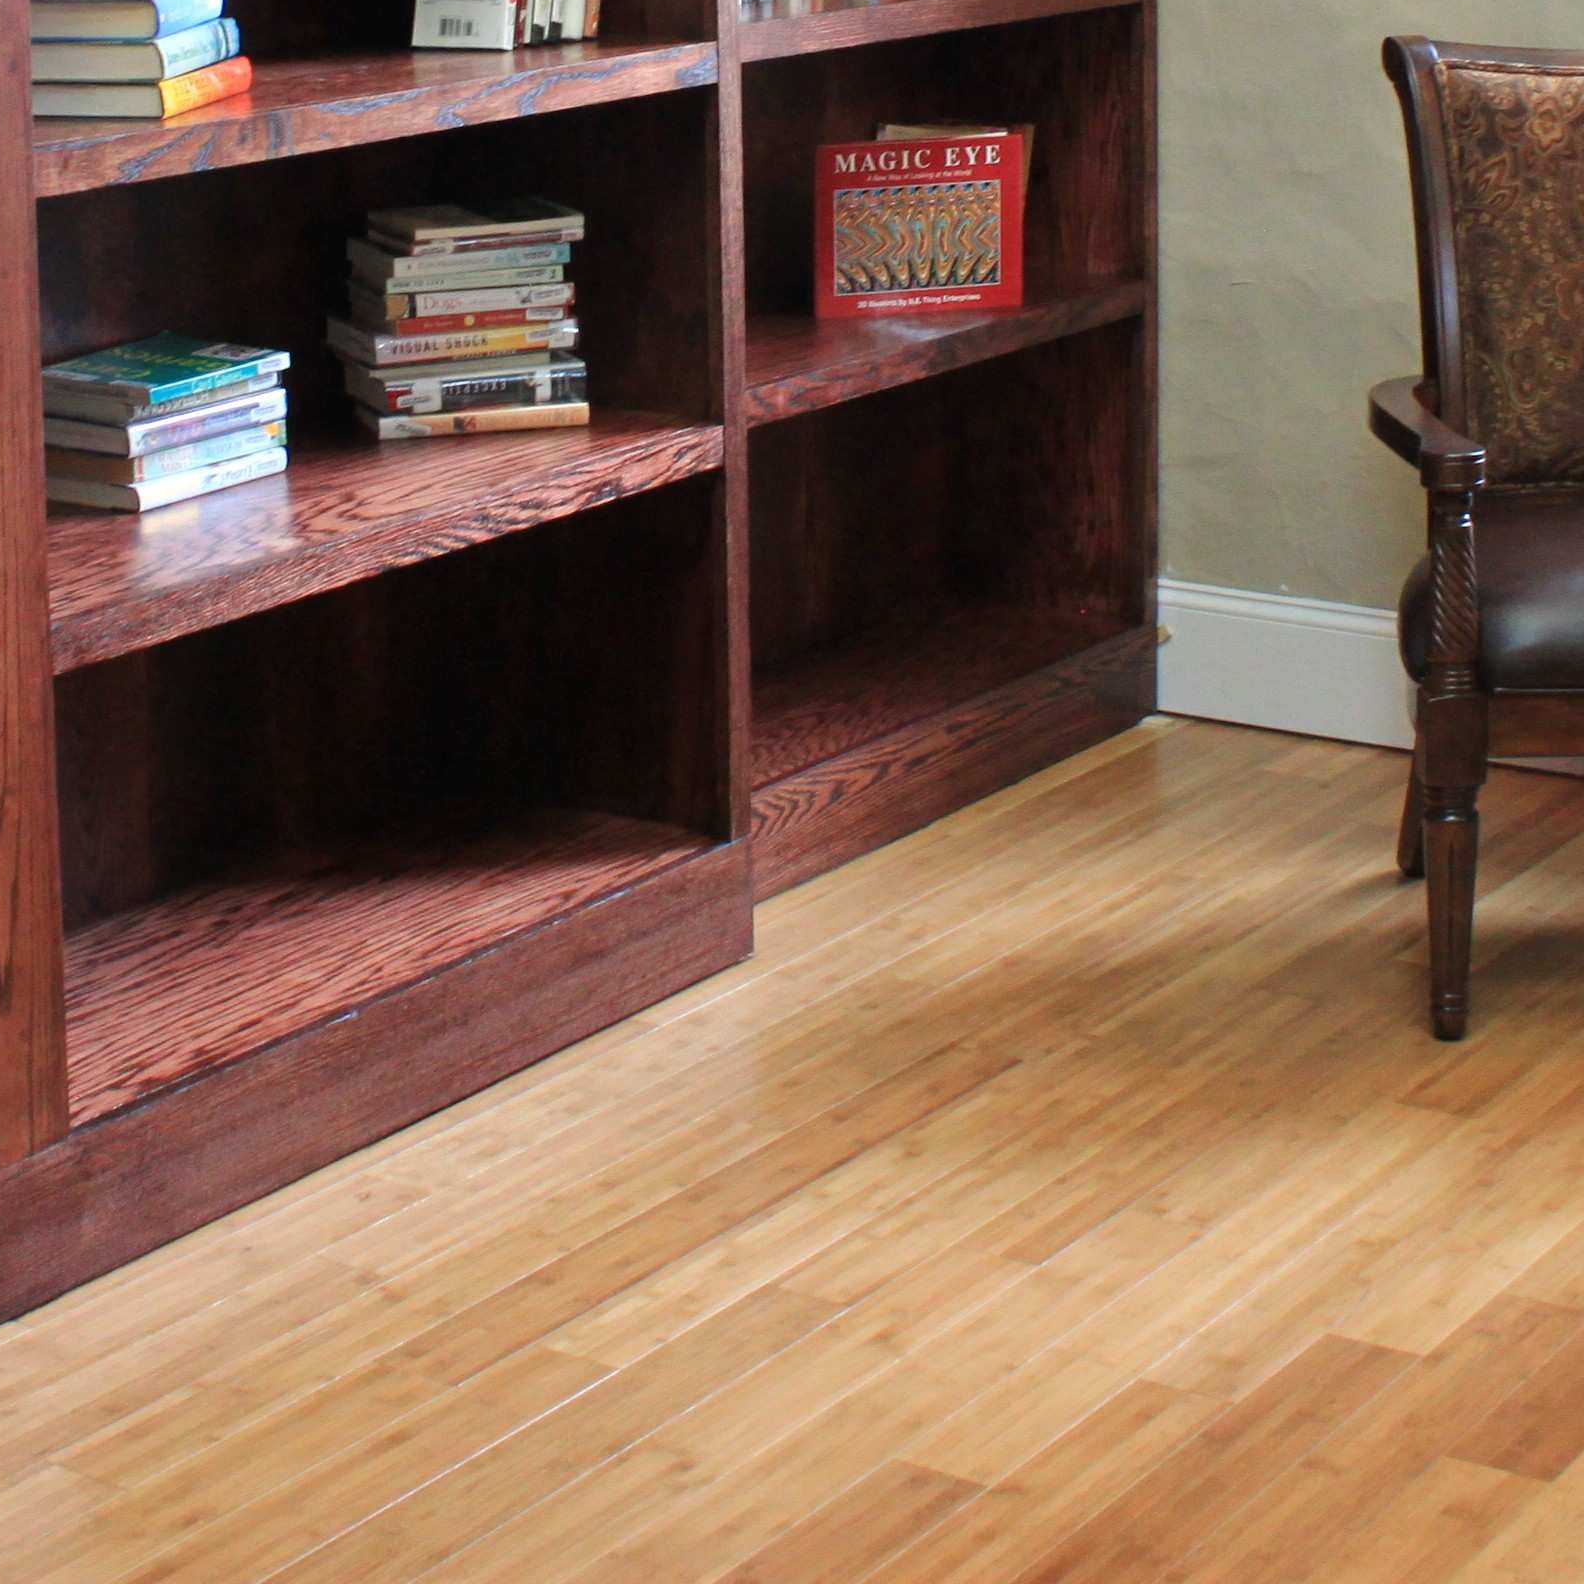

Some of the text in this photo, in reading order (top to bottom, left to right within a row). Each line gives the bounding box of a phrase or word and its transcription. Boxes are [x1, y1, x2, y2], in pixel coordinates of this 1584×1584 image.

[834, 144, 1001, 174] MAGIC EYE
[923, 296, 942, 305] Thing
[943, 293, 982, 303] Enterprises
[391, 334, 489, 355] VISUAL SHOCK
